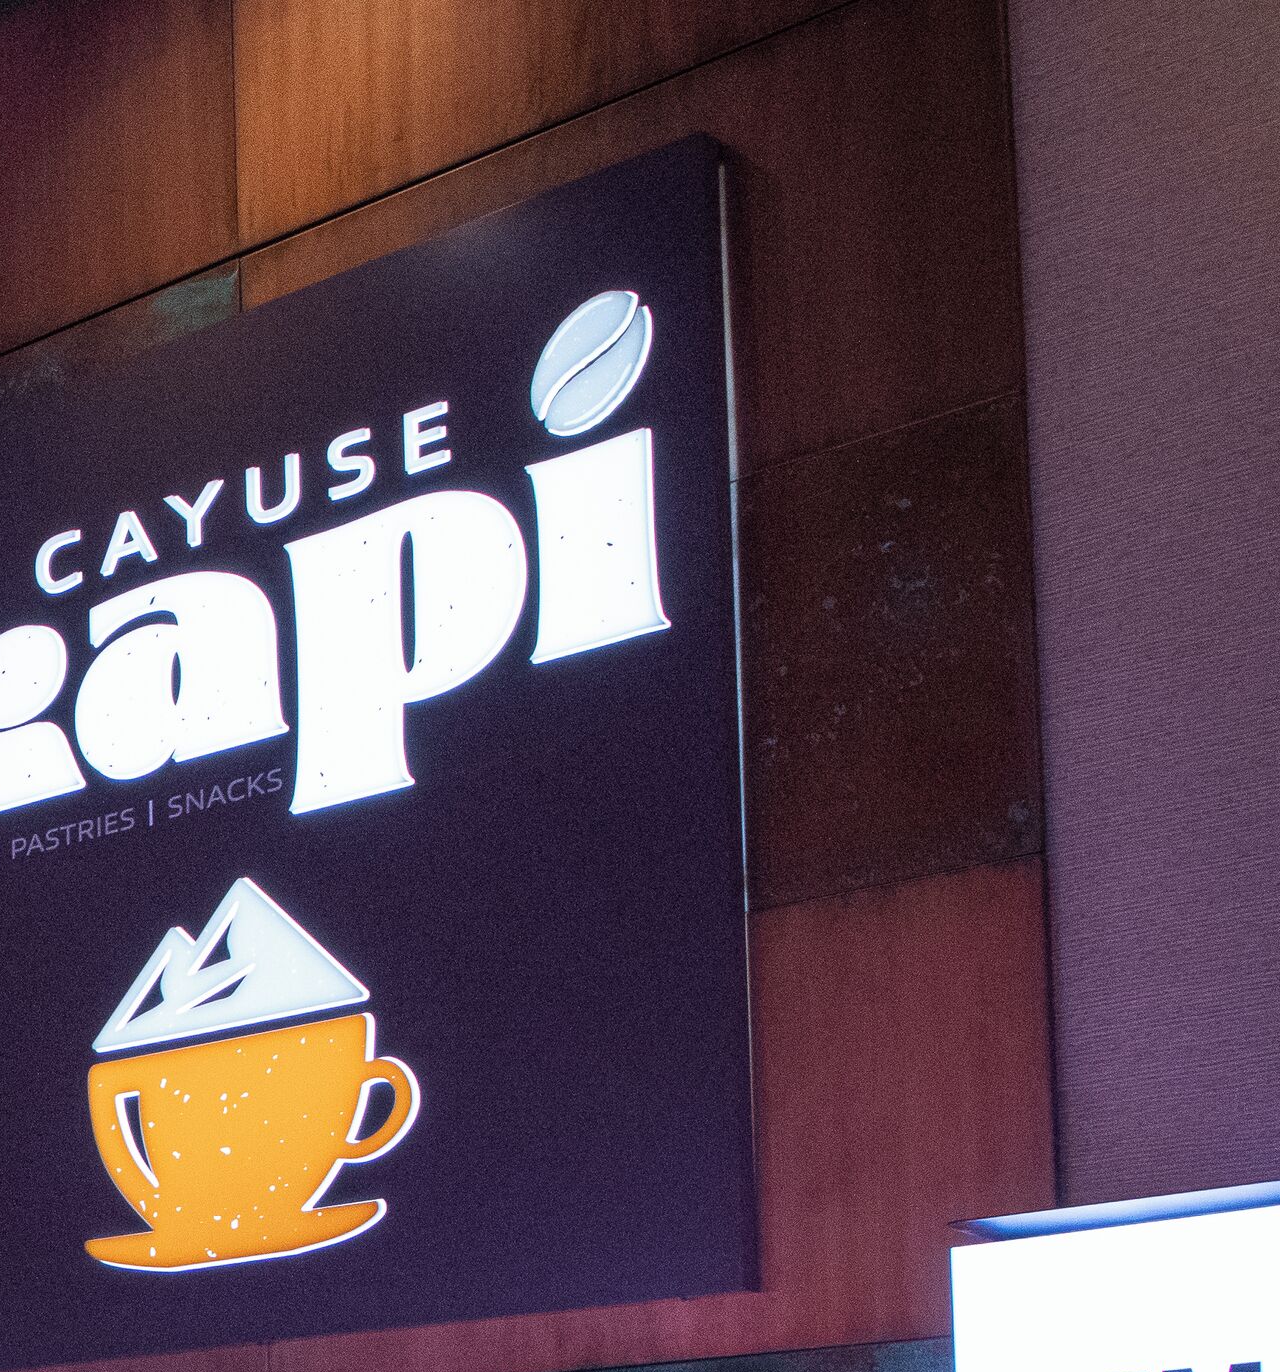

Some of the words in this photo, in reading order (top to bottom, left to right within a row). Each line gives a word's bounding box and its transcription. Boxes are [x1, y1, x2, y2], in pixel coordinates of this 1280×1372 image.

[34, 399, 453, 595] CAYUSE
[11, 807, 136, 859] PASTRIES
[167, 767, 283, 820] SNACKS
